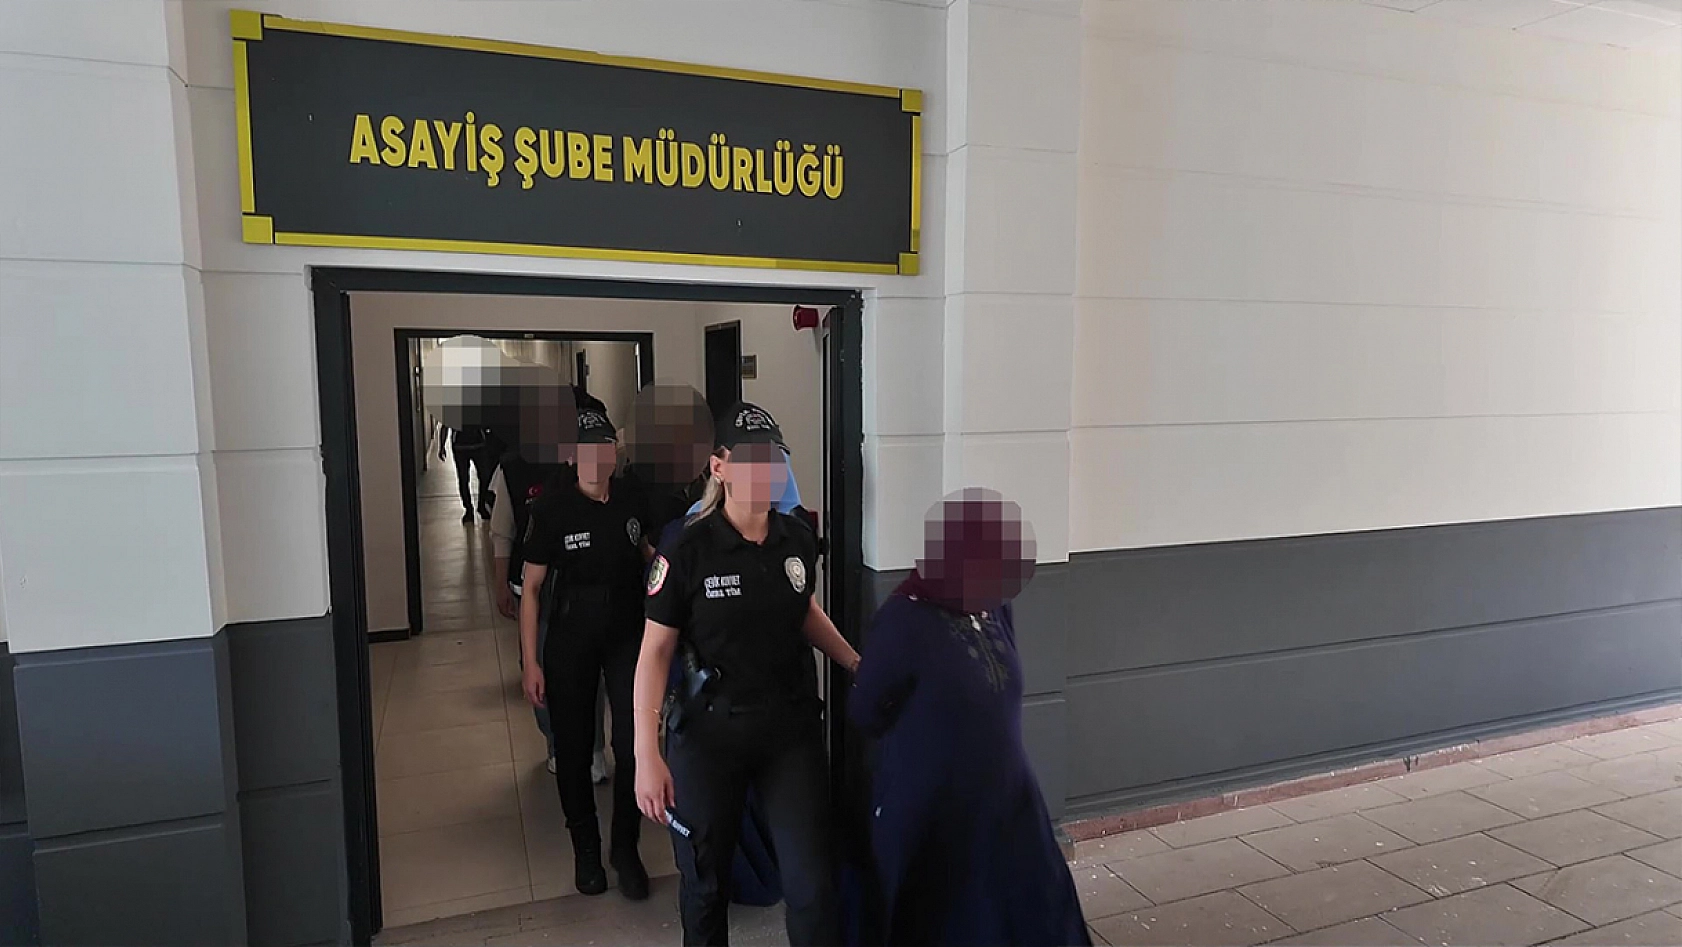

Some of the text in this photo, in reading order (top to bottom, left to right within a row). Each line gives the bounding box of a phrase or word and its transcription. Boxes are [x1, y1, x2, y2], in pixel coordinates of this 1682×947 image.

[350, 112, 844, 200] ASAYİŞ ŞUBE MÜDÜRLÜĞÜ
